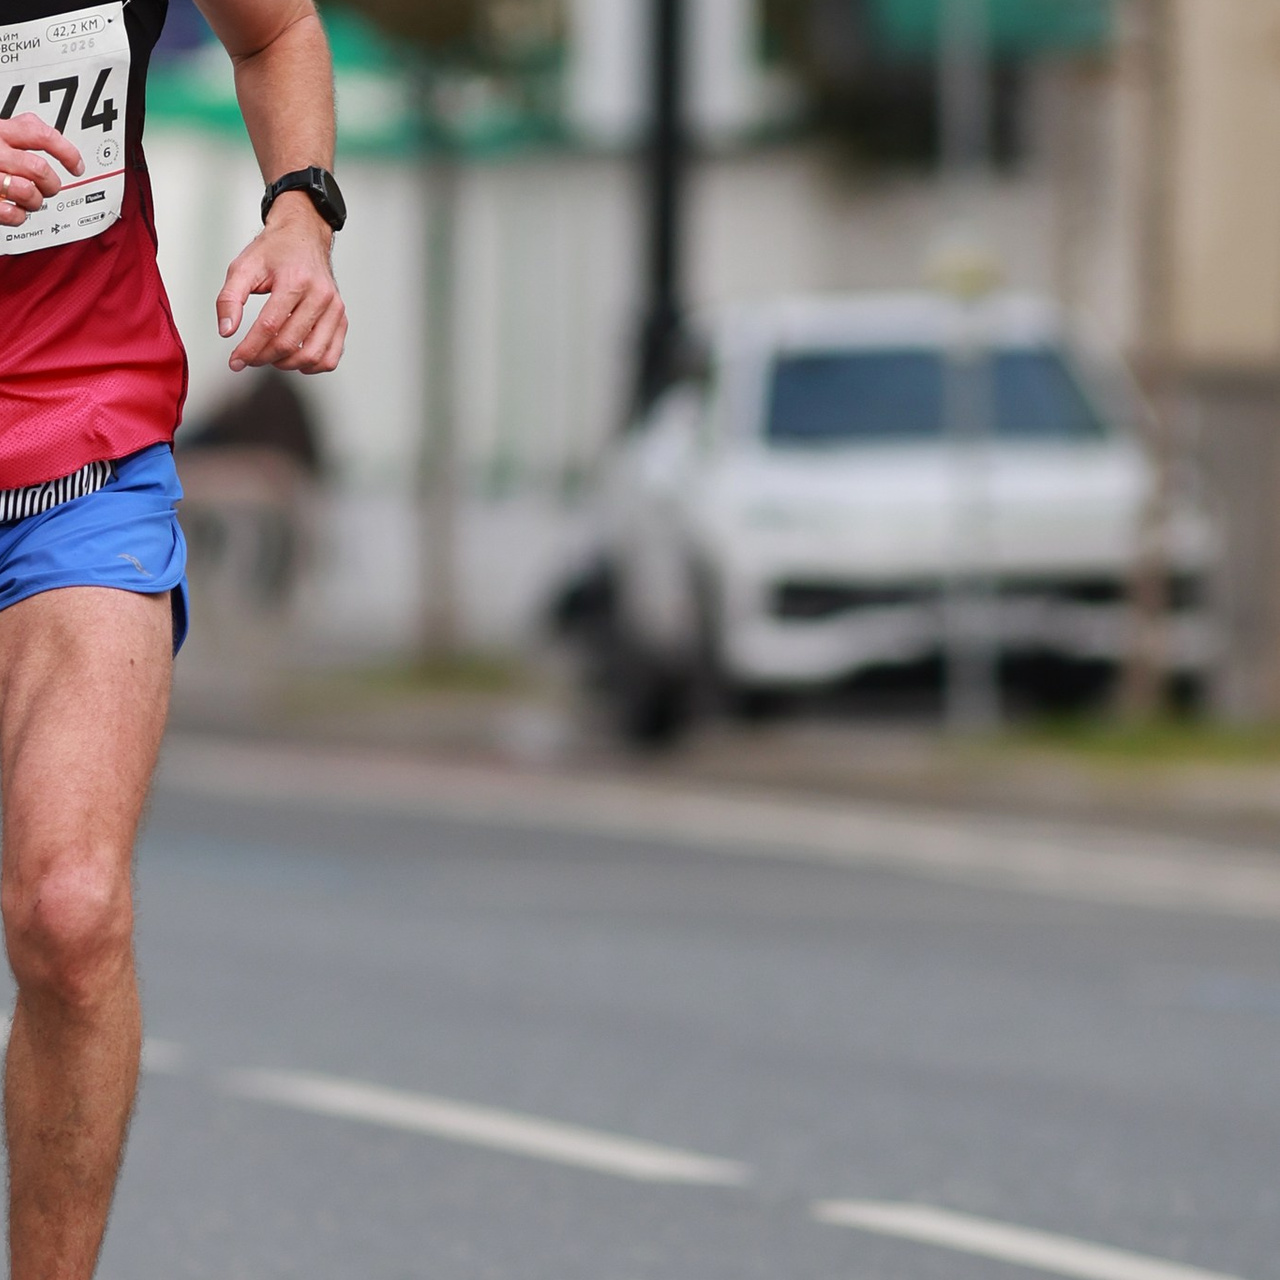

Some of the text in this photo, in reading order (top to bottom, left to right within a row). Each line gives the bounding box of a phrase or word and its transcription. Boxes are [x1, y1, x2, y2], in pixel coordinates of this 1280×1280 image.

[53, 19, 98, 38] 42,2 КМ
[103, 146, 111, 158] 6
[66, 198, 84, 208] СБЕР
